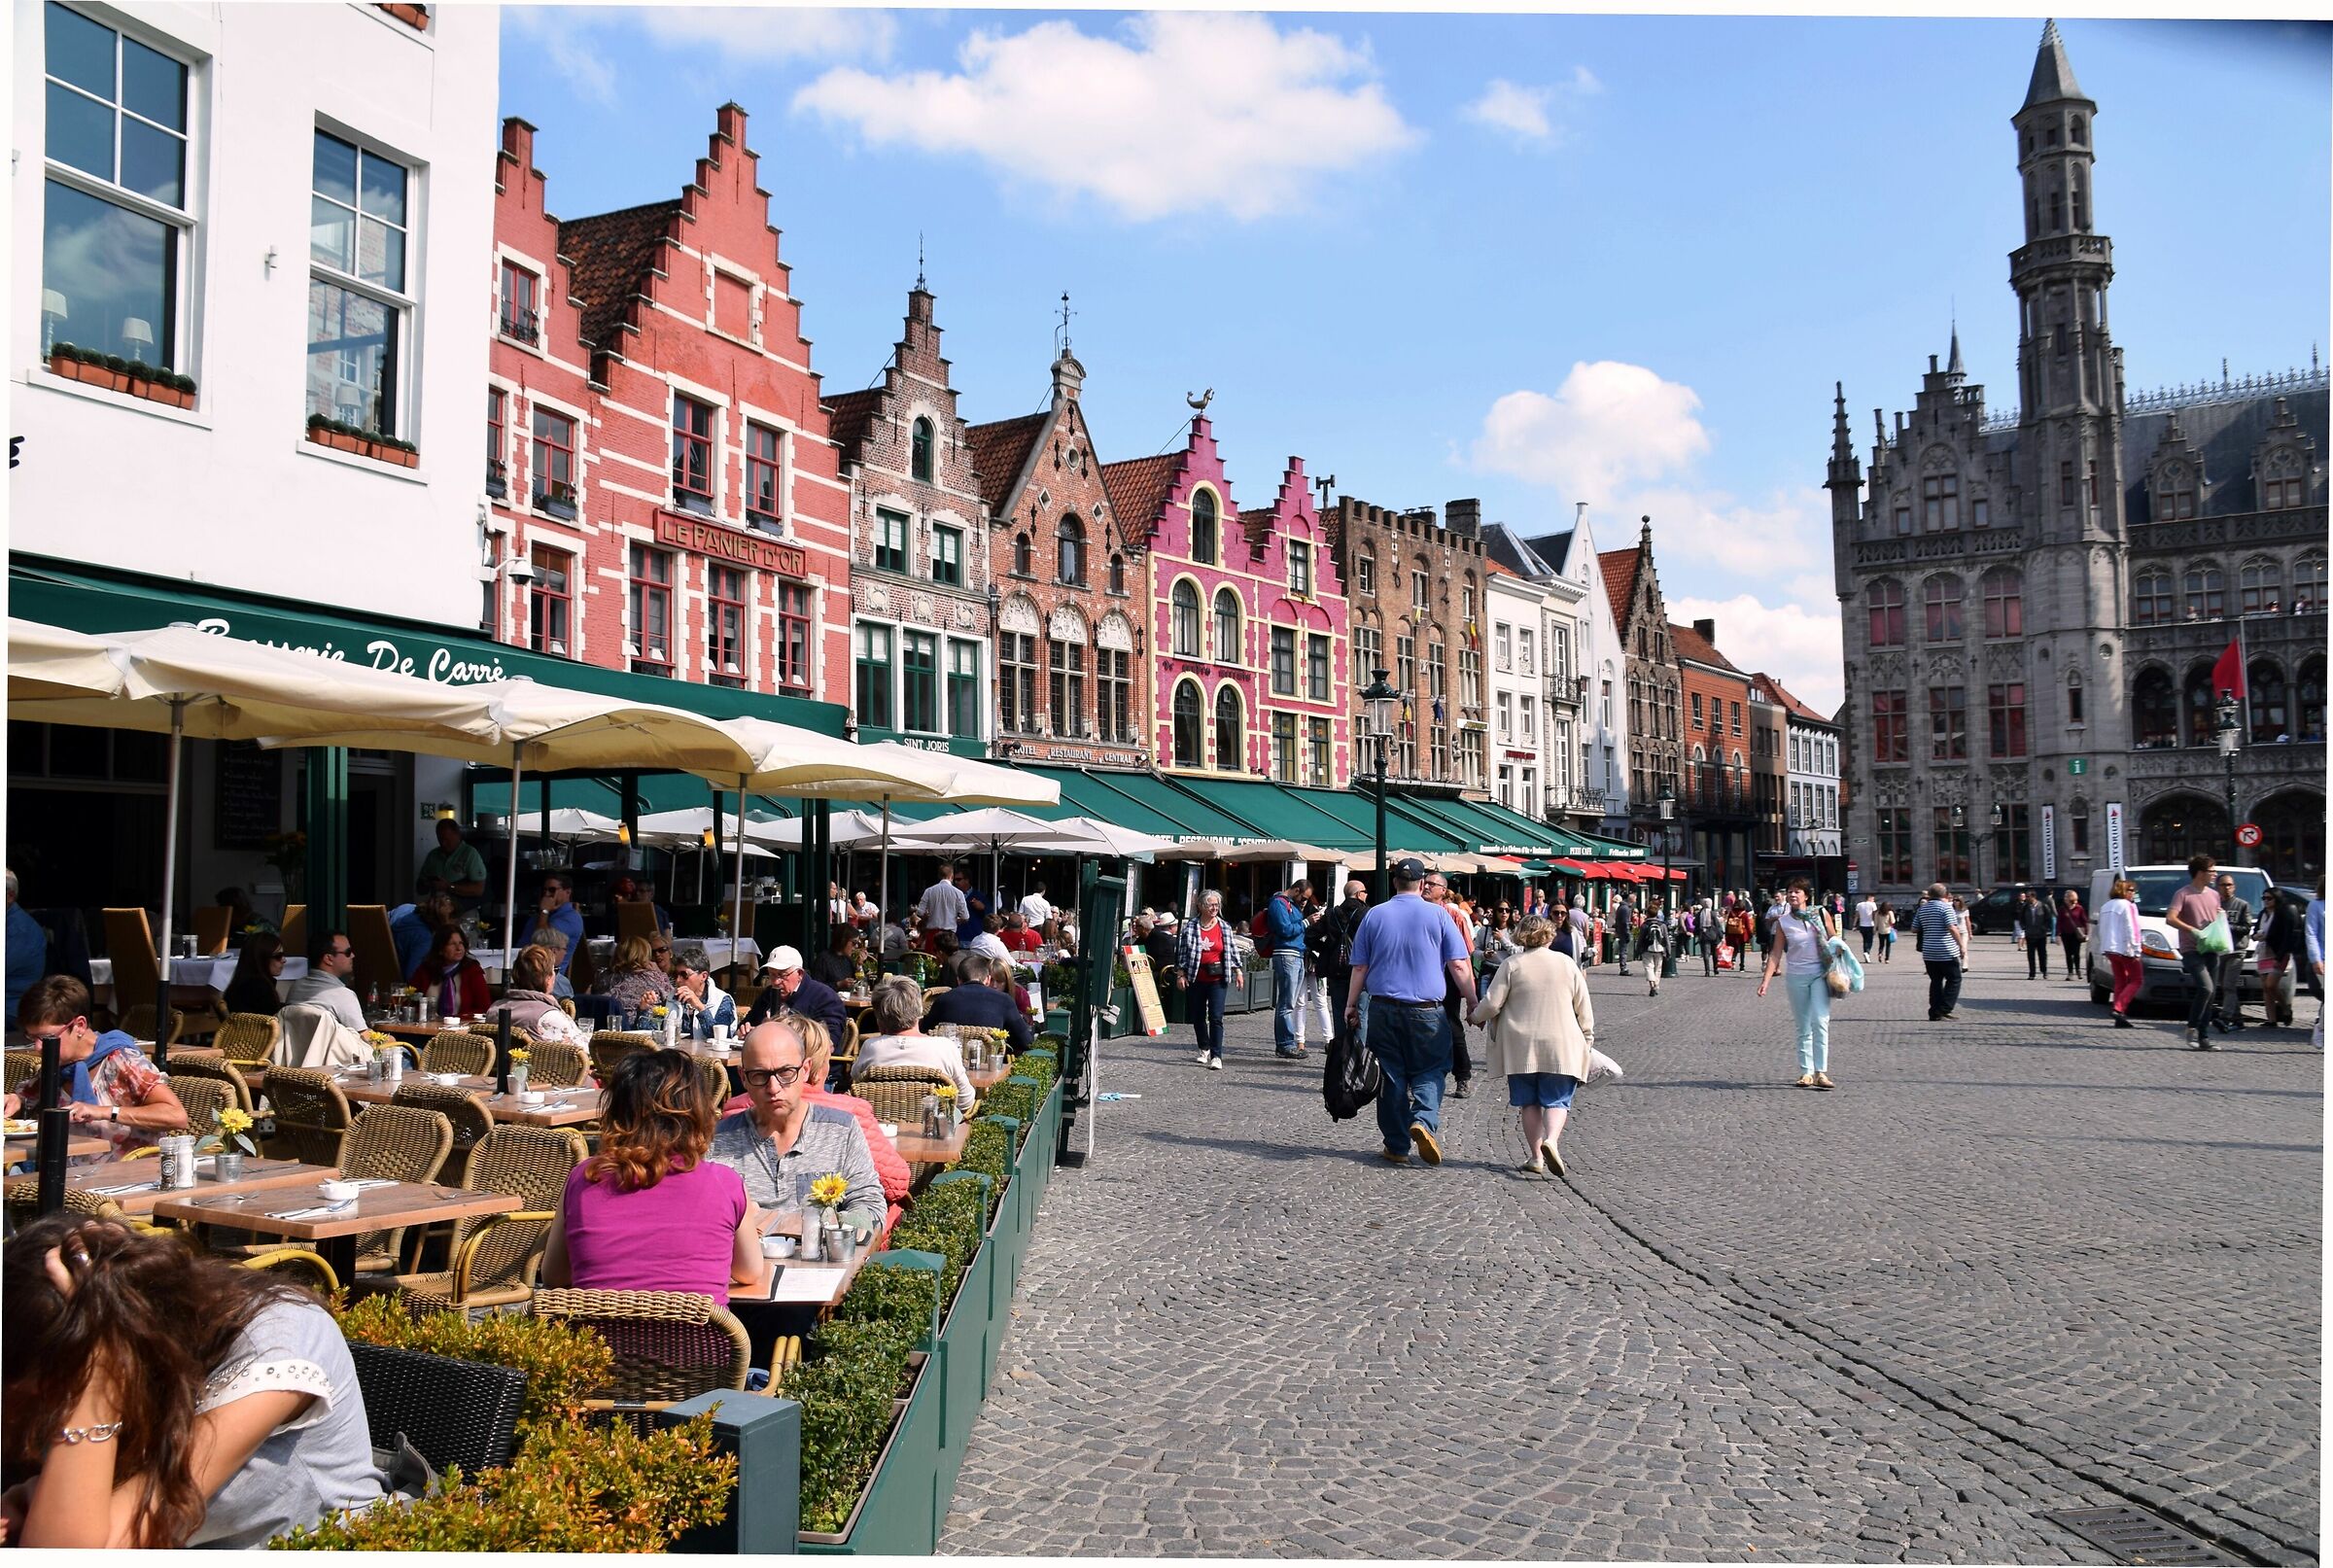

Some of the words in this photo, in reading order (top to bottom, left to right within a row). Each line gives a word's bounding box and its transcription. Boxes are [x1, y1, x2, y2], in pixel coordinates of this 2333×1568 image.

[664, 520, 686, 544] LE
[693, 523, 758, 564] PANIER
[764, 547, 801, 574] D'OR
[366, 640, 416, 677] De
[904, 737, 924, 750] SINT
[925, 739, 950, 752] JORIS
[1050, 747, 1093, 760] RESTAURANT
[1104, 751, 1132, 764] CENTRAL
